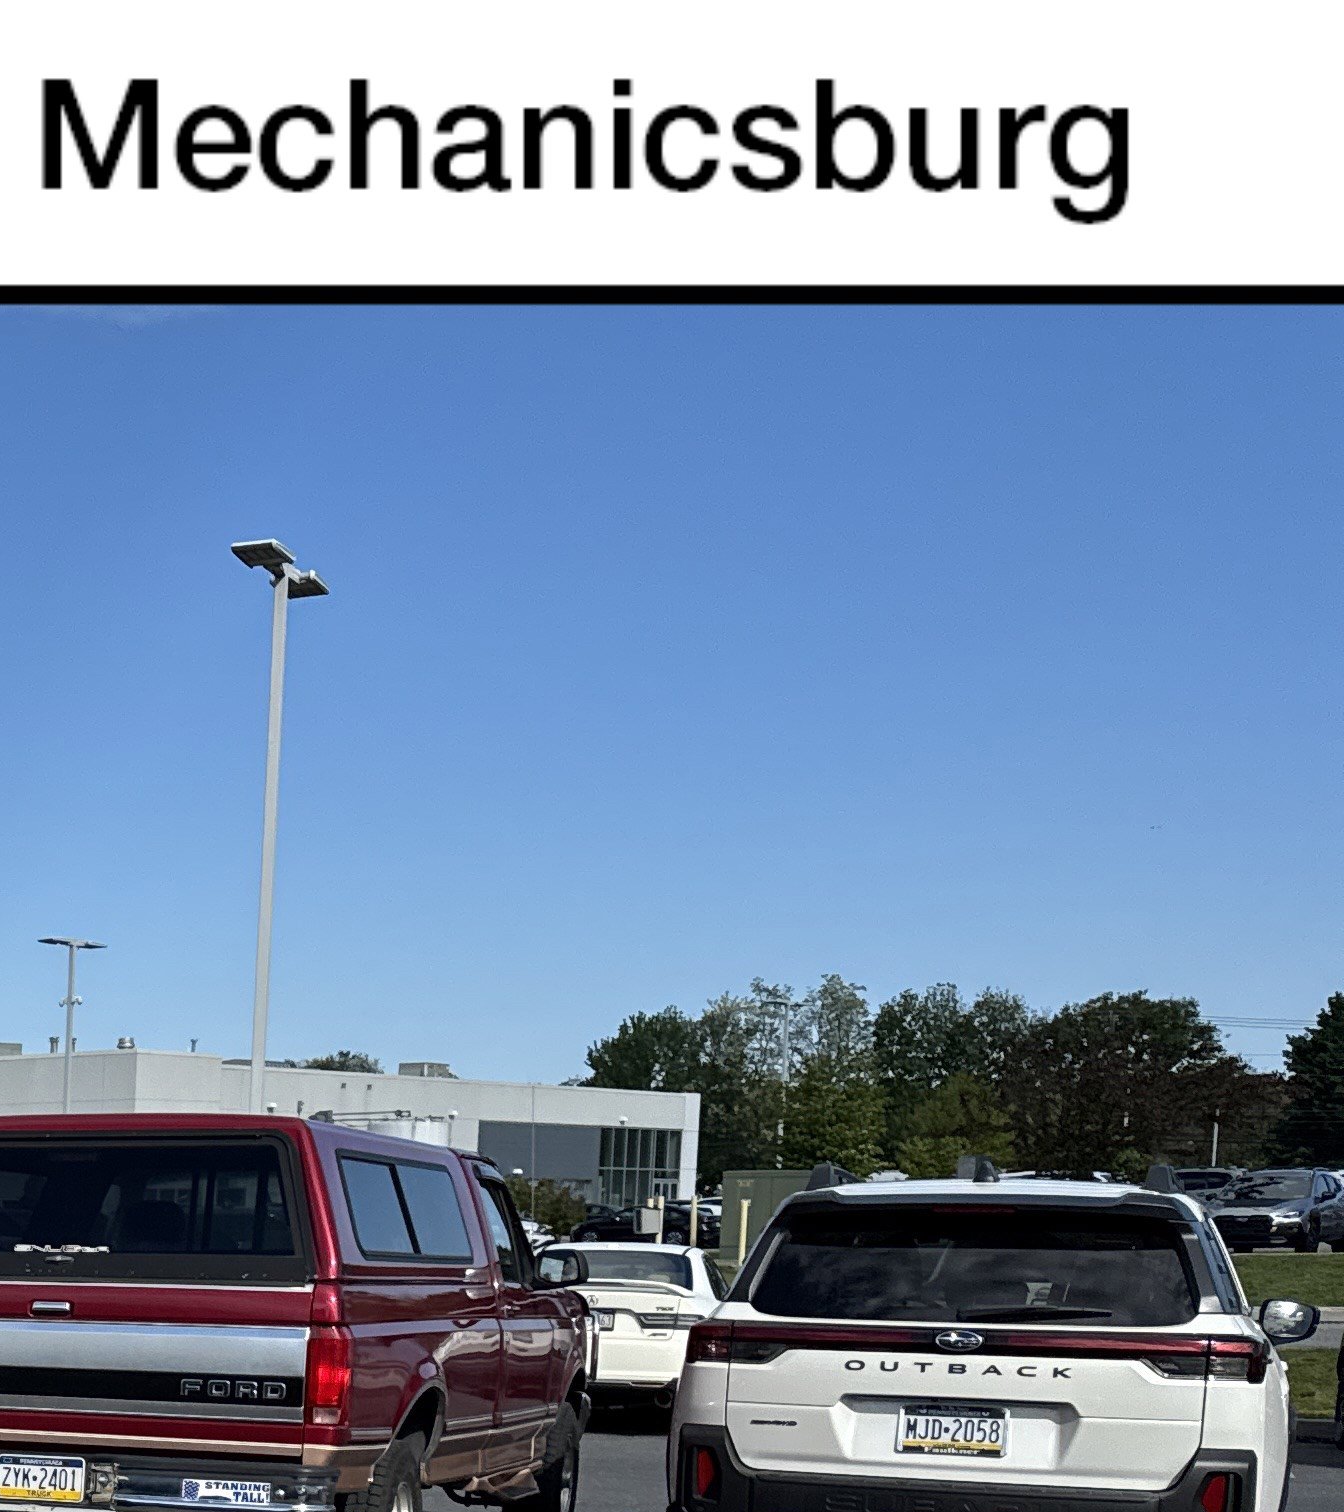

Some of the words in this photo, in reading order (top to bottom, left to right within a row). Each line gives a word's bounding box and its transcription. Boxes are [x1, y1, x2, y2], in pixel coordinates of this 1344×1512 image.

[844, 1359, 1072, 1379] OUTBACK
[179, 1378, 287, 1400] FORD
[204, 1481, 270, 1492] STANDING
[26, 1489, 52, 1498] TRUCK
[232, 1491, 270, 1504] TALL!
